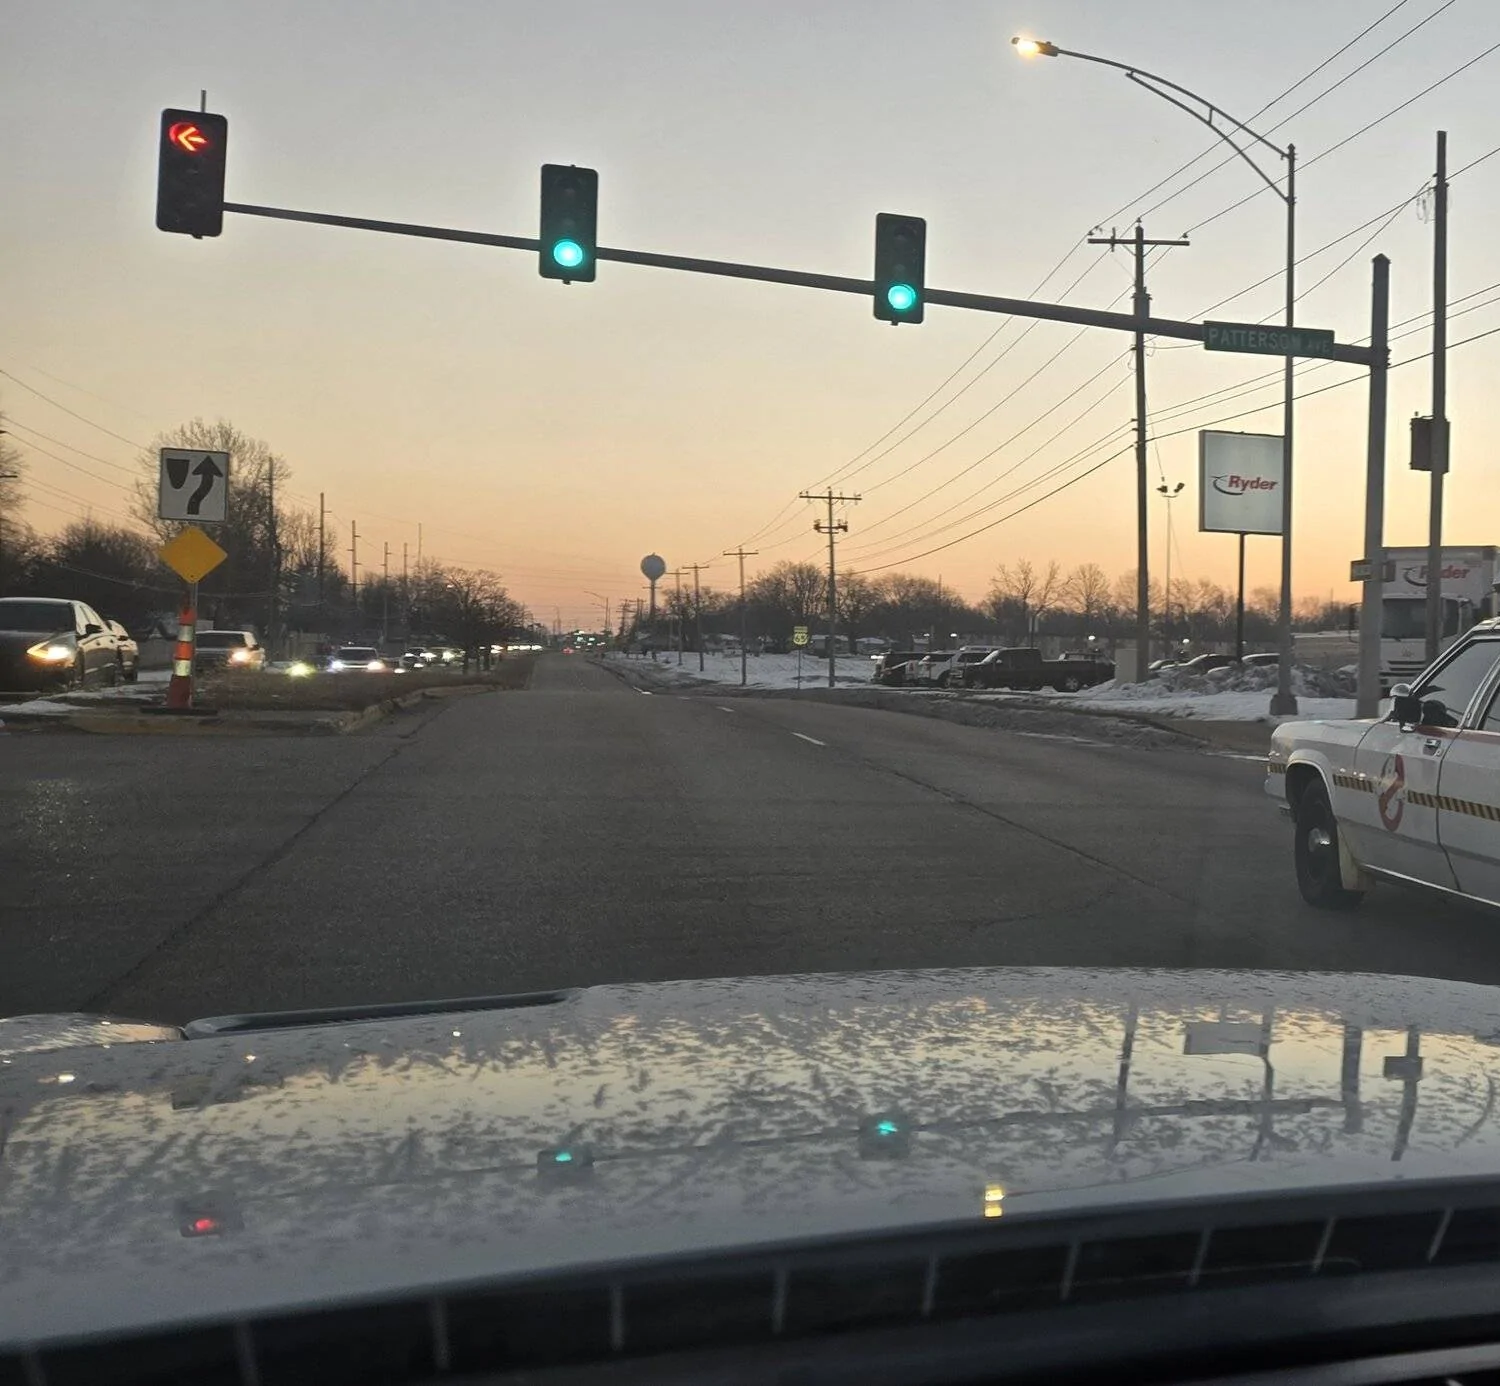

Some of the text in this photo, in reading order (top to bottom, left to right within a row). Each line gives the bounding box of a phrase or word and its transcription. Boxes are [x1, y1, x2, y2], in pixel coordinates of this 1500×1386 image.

[1208, 327, 1301, 351] PATTERSON
[1228, 474, 1278, 492] Ryder
[1419, 565, 1471, 580] Rder
